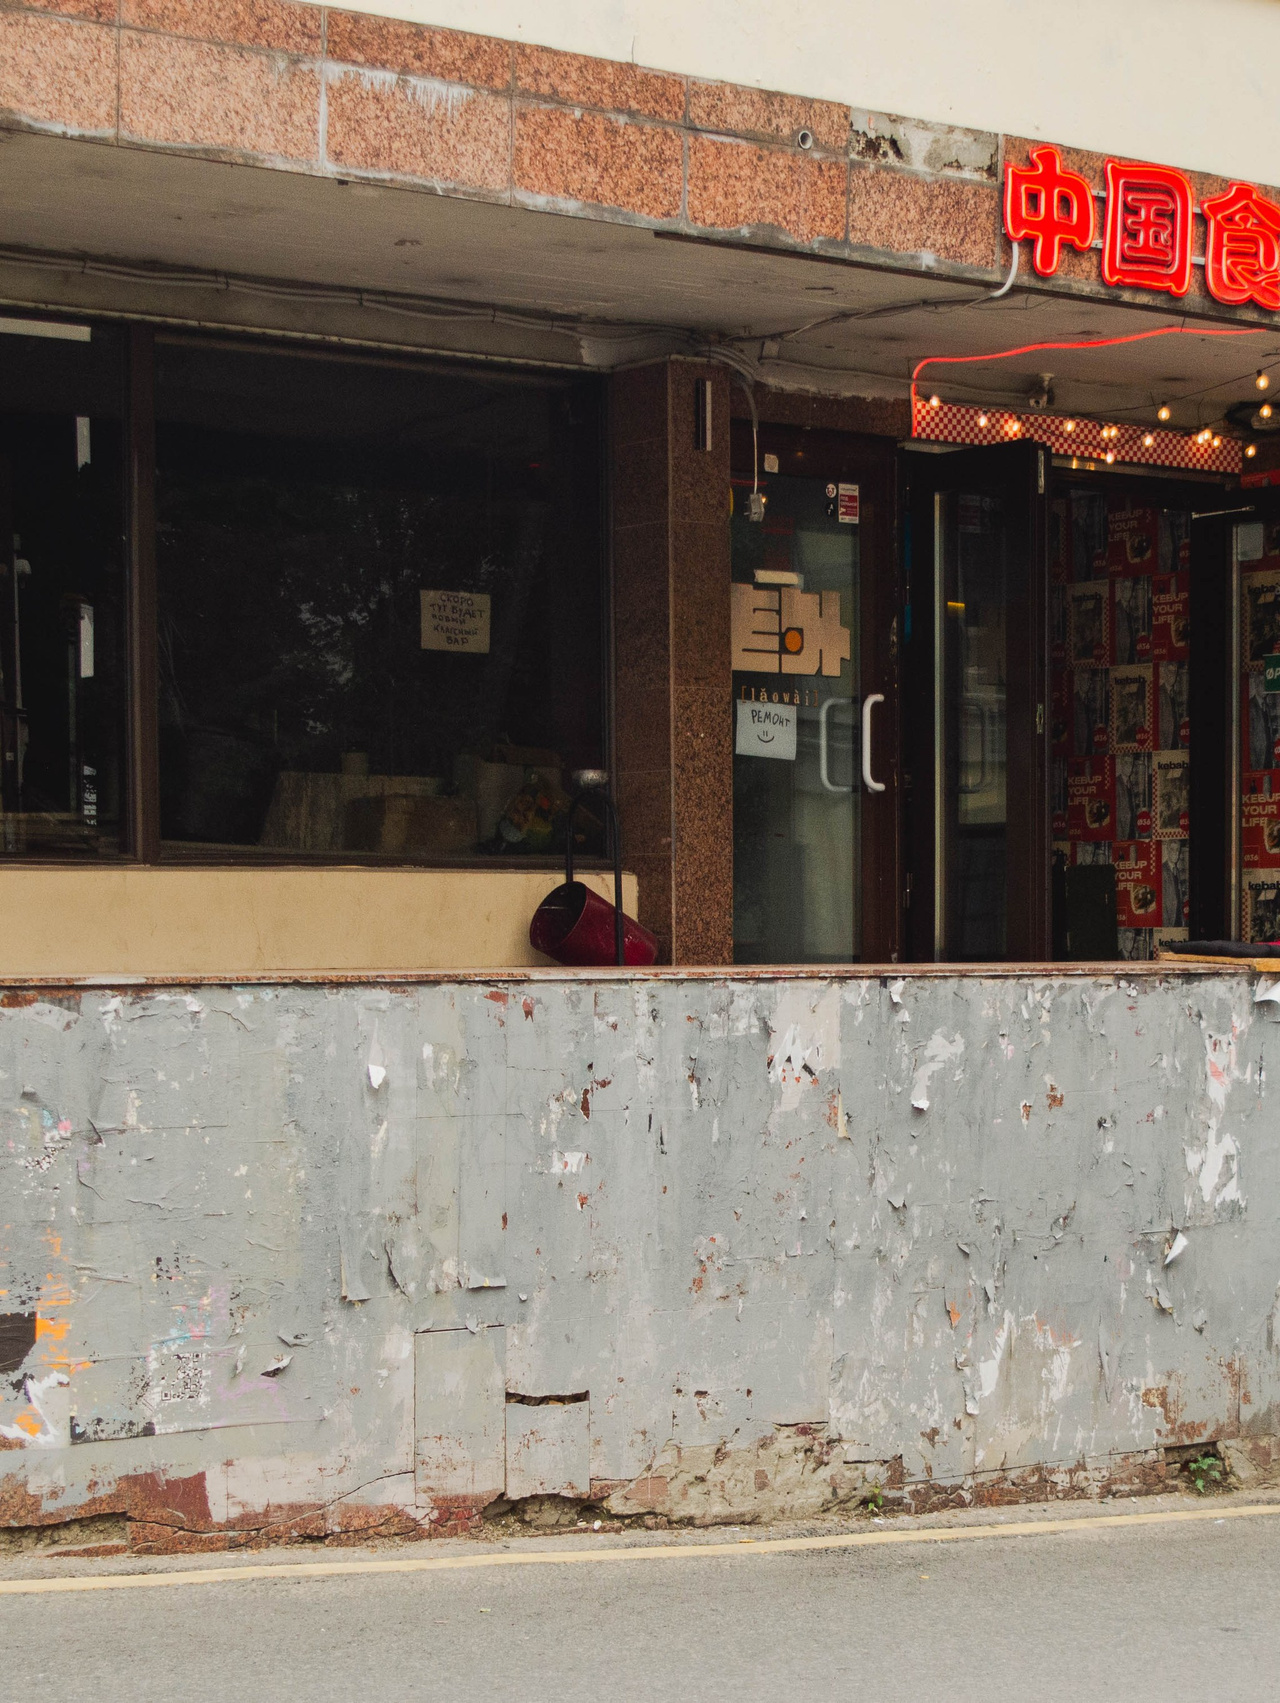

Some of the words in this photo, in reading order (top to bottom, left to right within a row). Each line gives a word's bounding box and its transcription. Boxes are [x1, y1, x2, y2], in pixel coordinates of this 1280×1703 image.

[440, 593, 474, 606] СКОРО
[1152, 592, 1189, 603] KEBUP
[429, 603, 447, 612] ТУТ
[451, 606, 485, 618] БУДЕТ
[1152, 603, 1183, 614] YOUR
[1152, 614, 1174, 625] LIFE
[446, 636, 469, 645] БАР
[751, 709, 791, 728] РЕМОНТ
[1067, 776, 1102, 785] KEBUP
[1067, 786, 1097, 795] YOUR
[1067, 796, 1089, 806] LIFE
[1242, 805, 1277, 815] YOUR
[1242, 817, 1267, 827] LIFE
